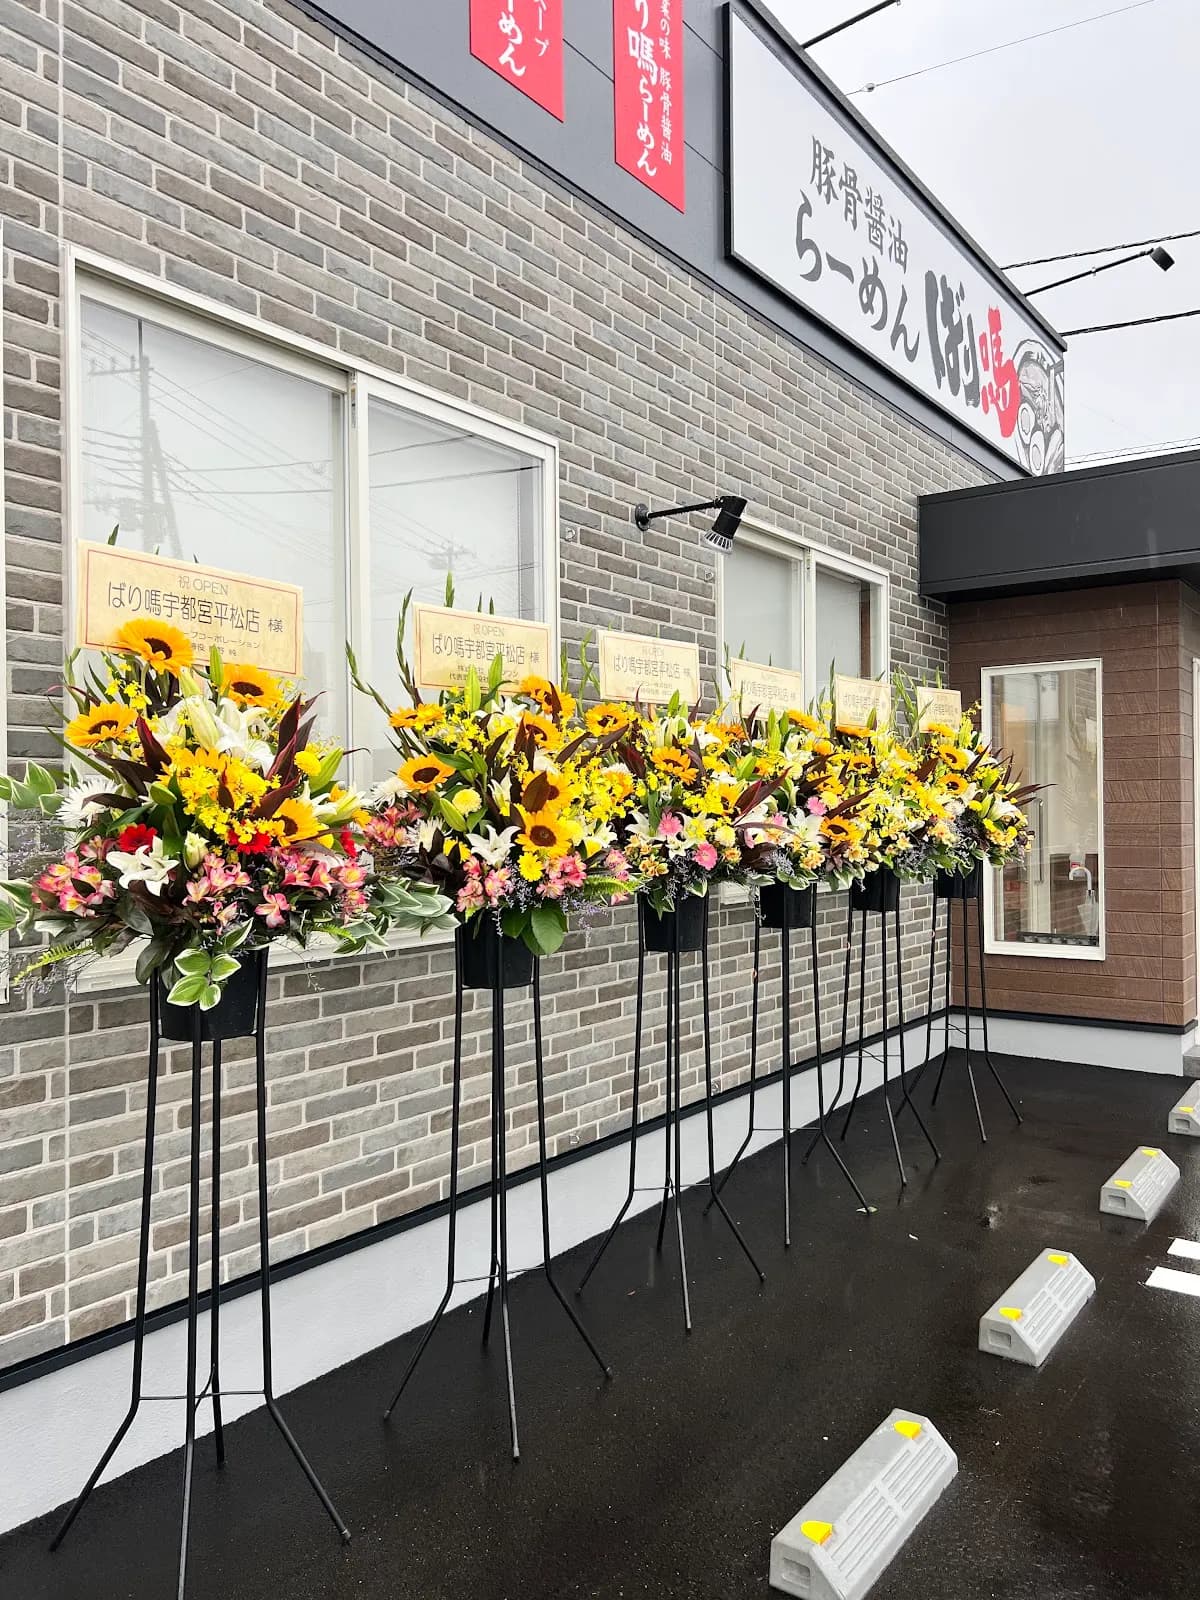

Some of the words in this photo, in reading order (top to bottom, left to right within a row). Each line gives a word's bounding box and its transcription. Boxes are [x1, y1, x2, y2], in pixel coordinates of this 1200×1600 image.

[795, 188, 921, 364] らーめん
[810, 135, 909, 275] 豚骨醤油
